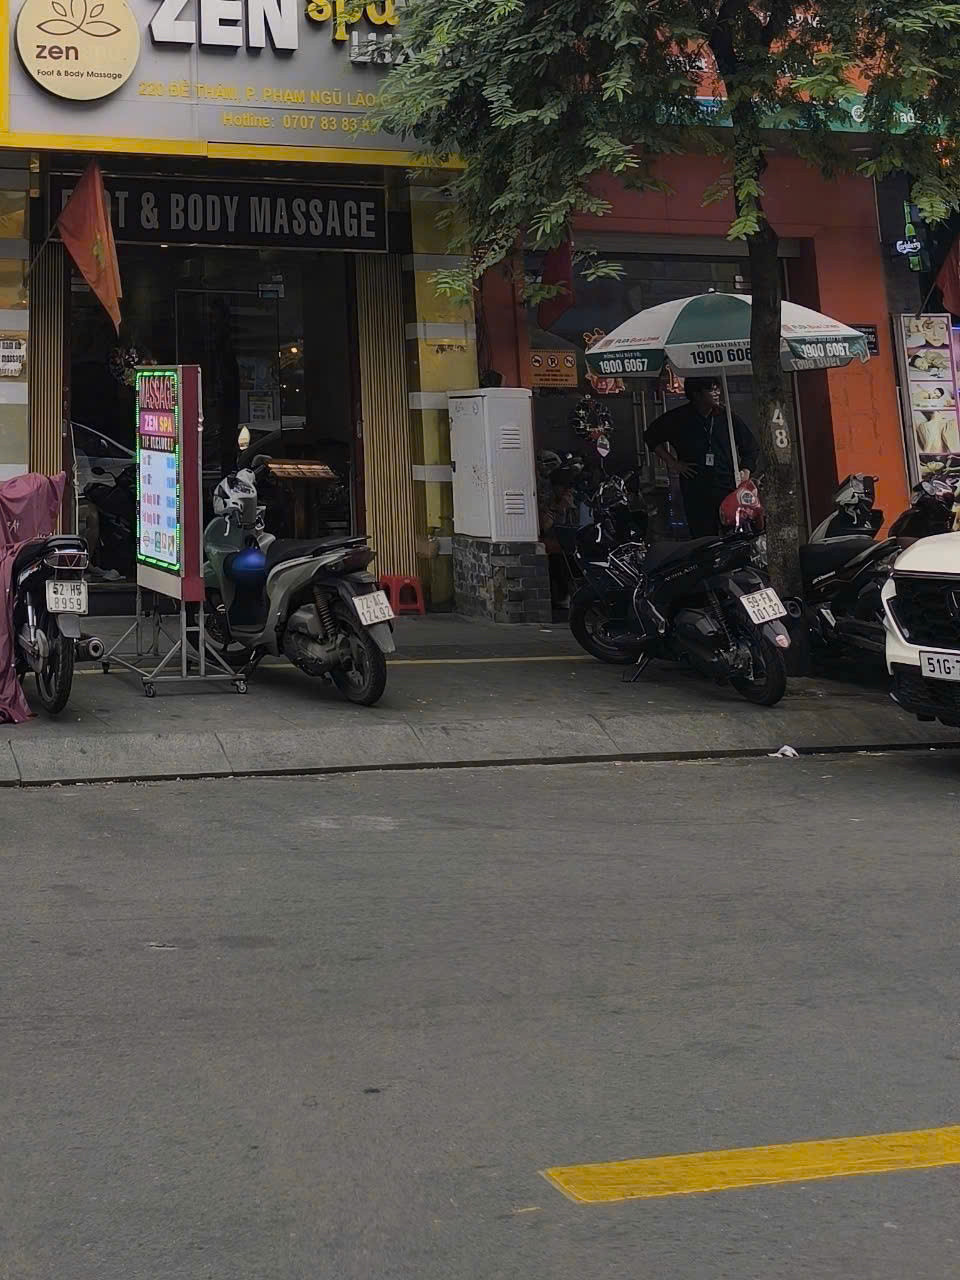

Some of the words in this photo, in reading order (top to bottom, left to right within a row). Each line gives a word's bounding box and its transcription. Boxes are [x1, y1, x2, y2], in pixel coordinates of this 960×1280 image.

[36, 44, 79, 61] zen
[37, 69, 54, 77] Foot
[64, 70, 85, 78] Body
[86, 71, 123, 80] Massage
[310, 87, 343, 107] NGŨ
[223, 111, 275, 129] Hotline:
[283, 115, 316, 130] 0707
[320, 116, 337, 131] 83
[341, 117, 357, 132] 83
[140, 191, 159, 229] &
[170, 193, 240, 232] BODY
[250, 196, 376, 238] MASSAGE
[690, 349, 724, 365] 1900
[727, 347, 752, 362] 606
[801, 343, 825, 358] 1900
[826, 342, 850, 357] 6067
[599, 359, 622, 374] 1900
[624, 358, 648, 372] 6067
[139, 376, 175, 410] MASSAGE
[144, 414, 159, 432] ZEN
[159, 415, 173, 433] SPA
[54, 596, 82, 610] 8959
[746, 591, 774, 608] 59-FA
